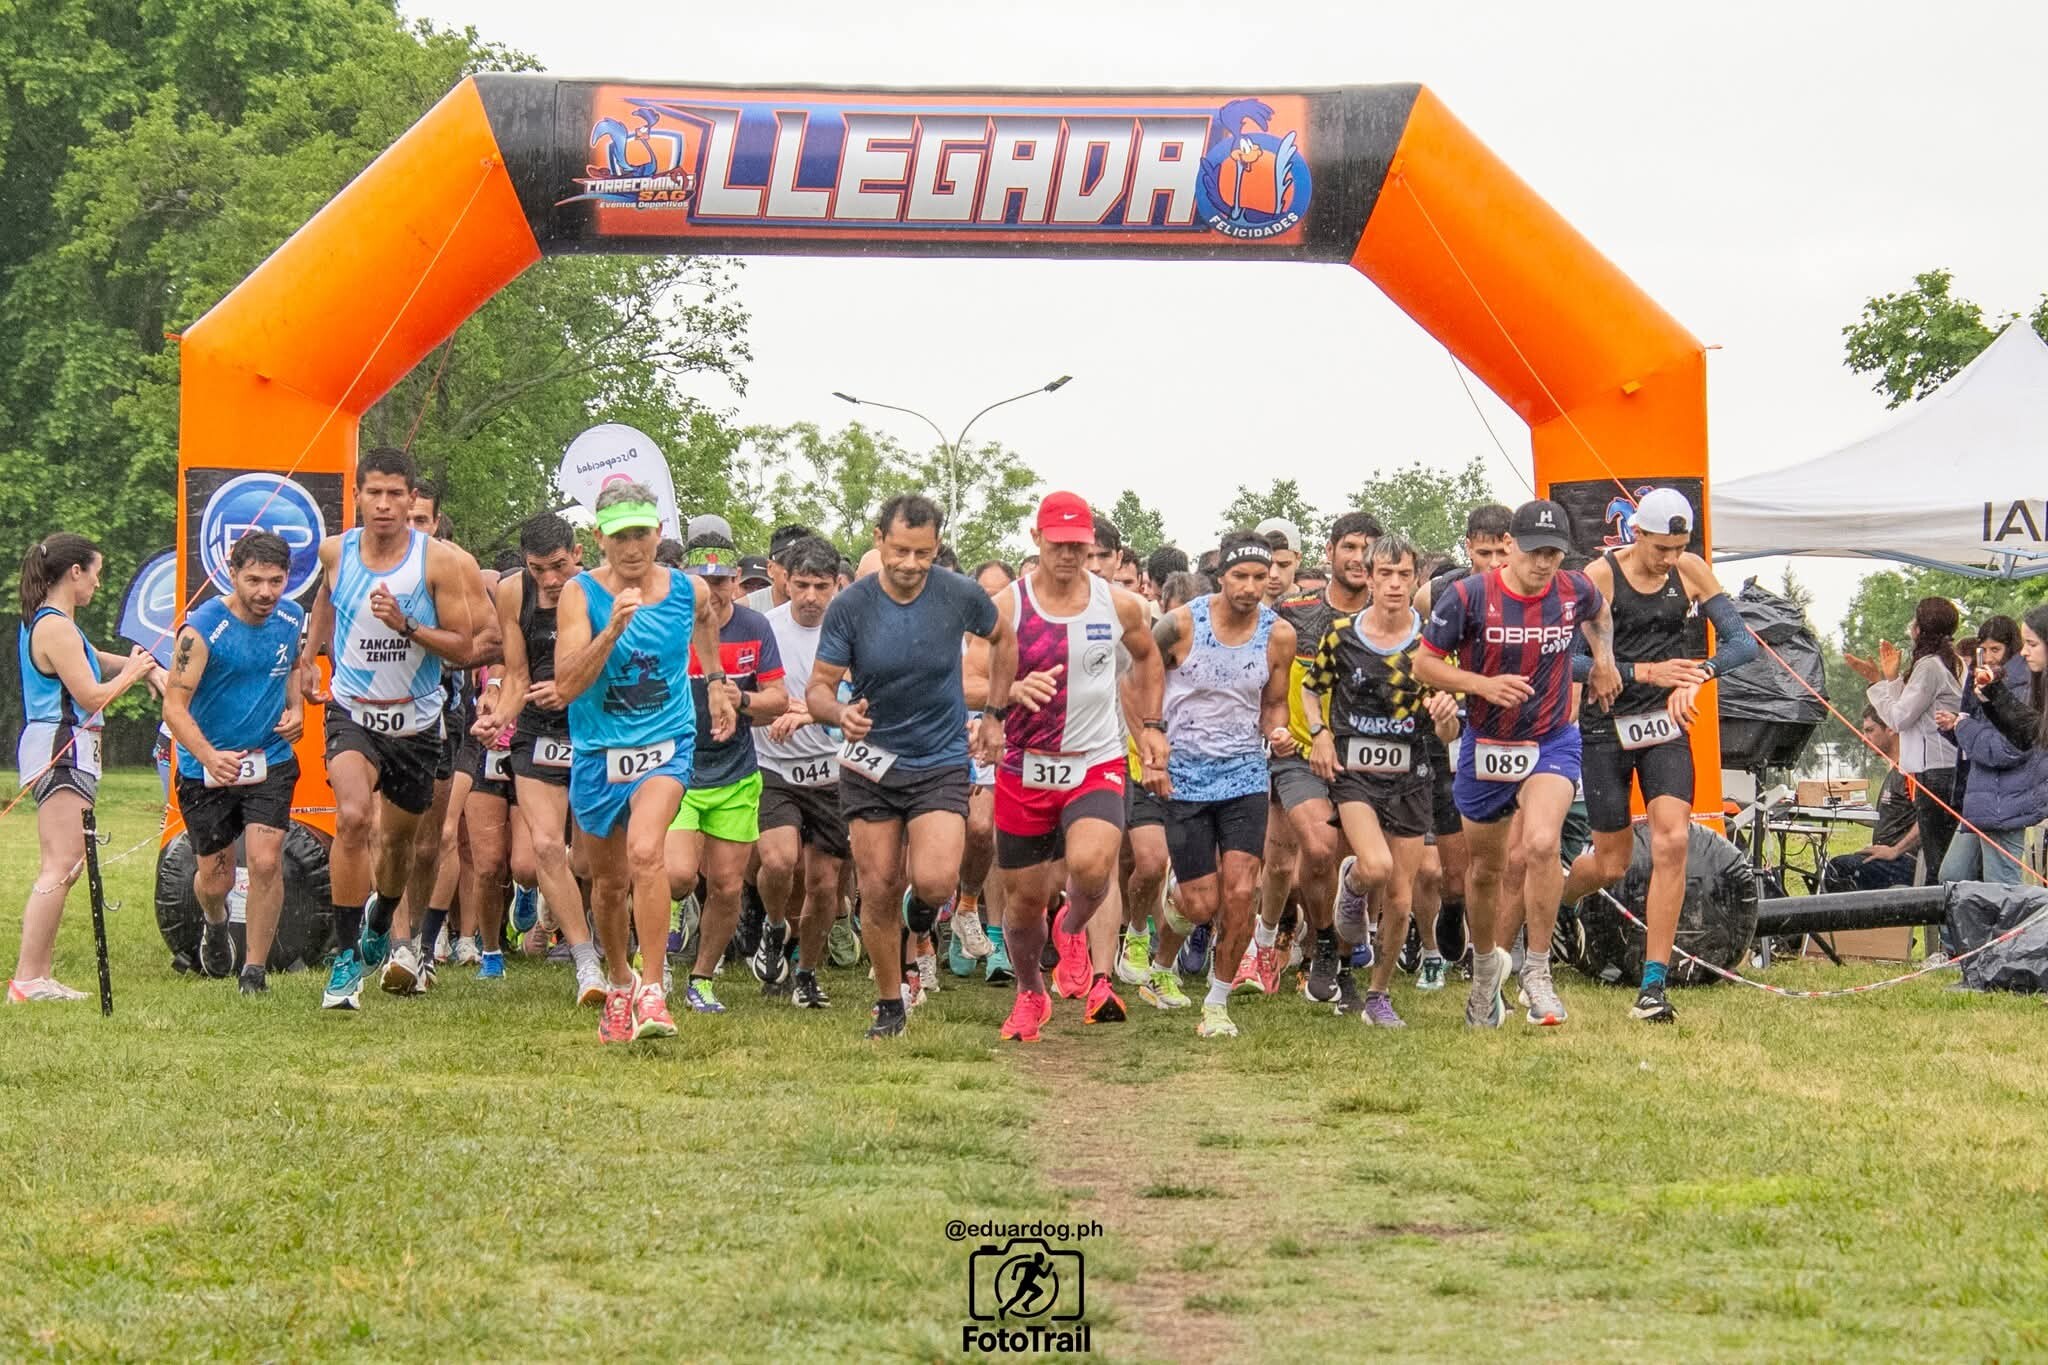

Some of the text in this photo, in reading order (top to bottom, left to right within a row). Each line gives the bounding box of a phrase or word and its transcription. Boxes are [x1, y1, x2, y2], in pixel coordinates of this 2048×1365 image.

[662, 105, 1213, 226] LLEGADA
[600, 200, 689, 210] Eventos Deportivos
[639, 190, 687, 200] SAG
[1209, 212, 1298, 238] FELICIDADES
[1983, 500, 2048, 541] IA
[209, 618, 229, 643] PEDRO
[1485, 625, 1574, 644] OBRAS
[360, 638, 411, 650] ZANCADA
[366, 651, 406, 662] ZENITH
[362, 711, 405, 732] 050
[1628, 719, 1670, 742] 040
[545, 743, 571, 761] 02
[843, 743, 883, 771] 094
[1358, 746, 1402, 766] 090
[619, 750, 662, 776] 023
[792, 760, 831, 783] 044
[1033, 763, 1072, 784] 312
[1485, 753, 1529, 774] 089
